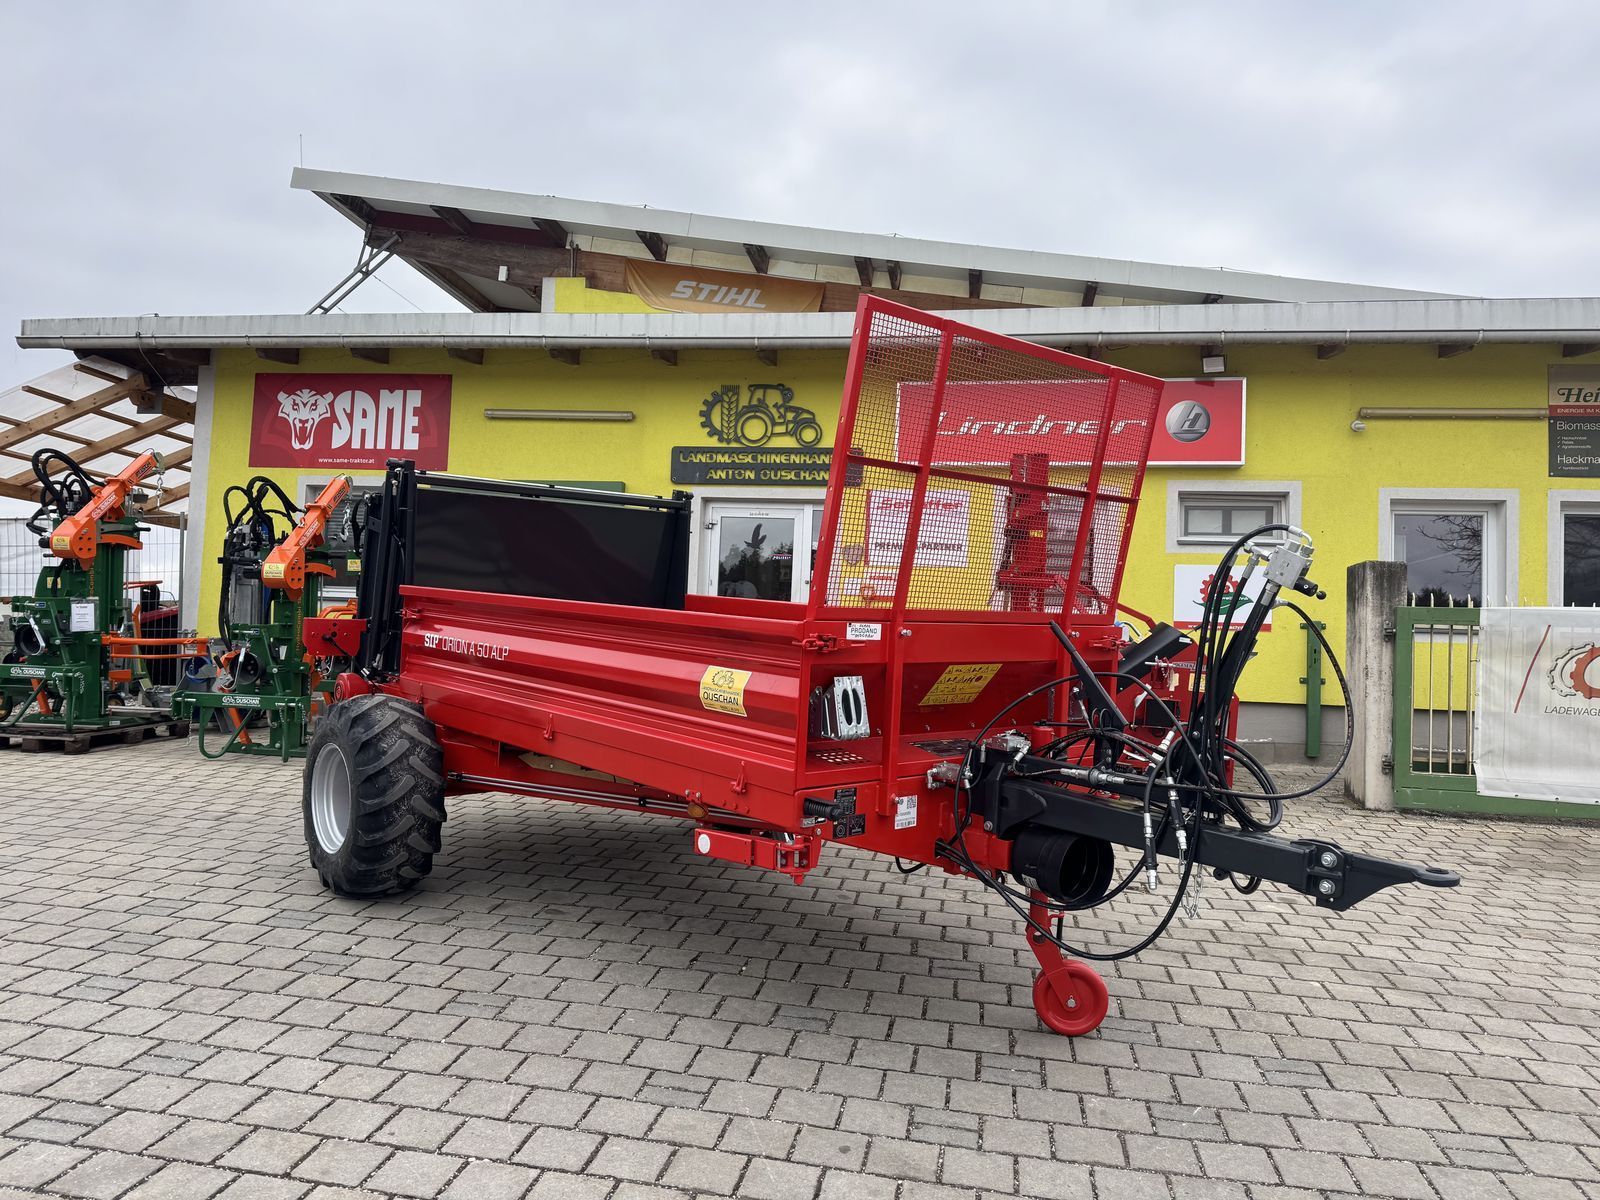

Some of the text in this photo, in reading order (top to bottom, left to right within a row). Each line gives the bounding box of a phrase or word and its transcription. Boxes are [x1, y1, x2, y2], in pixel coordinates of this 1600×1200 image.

[671, 280, 766, 308] STIHL
[331, 389, 422, 450] SAME
[936, 411, 1147, 435] Lindner
[706, 468, 829, 480] ANTON OUSCHAN
[425, 633, 509, 661] SIP ORION A 50 ALP
[703, 691, 739, 706] OUSCHAN
